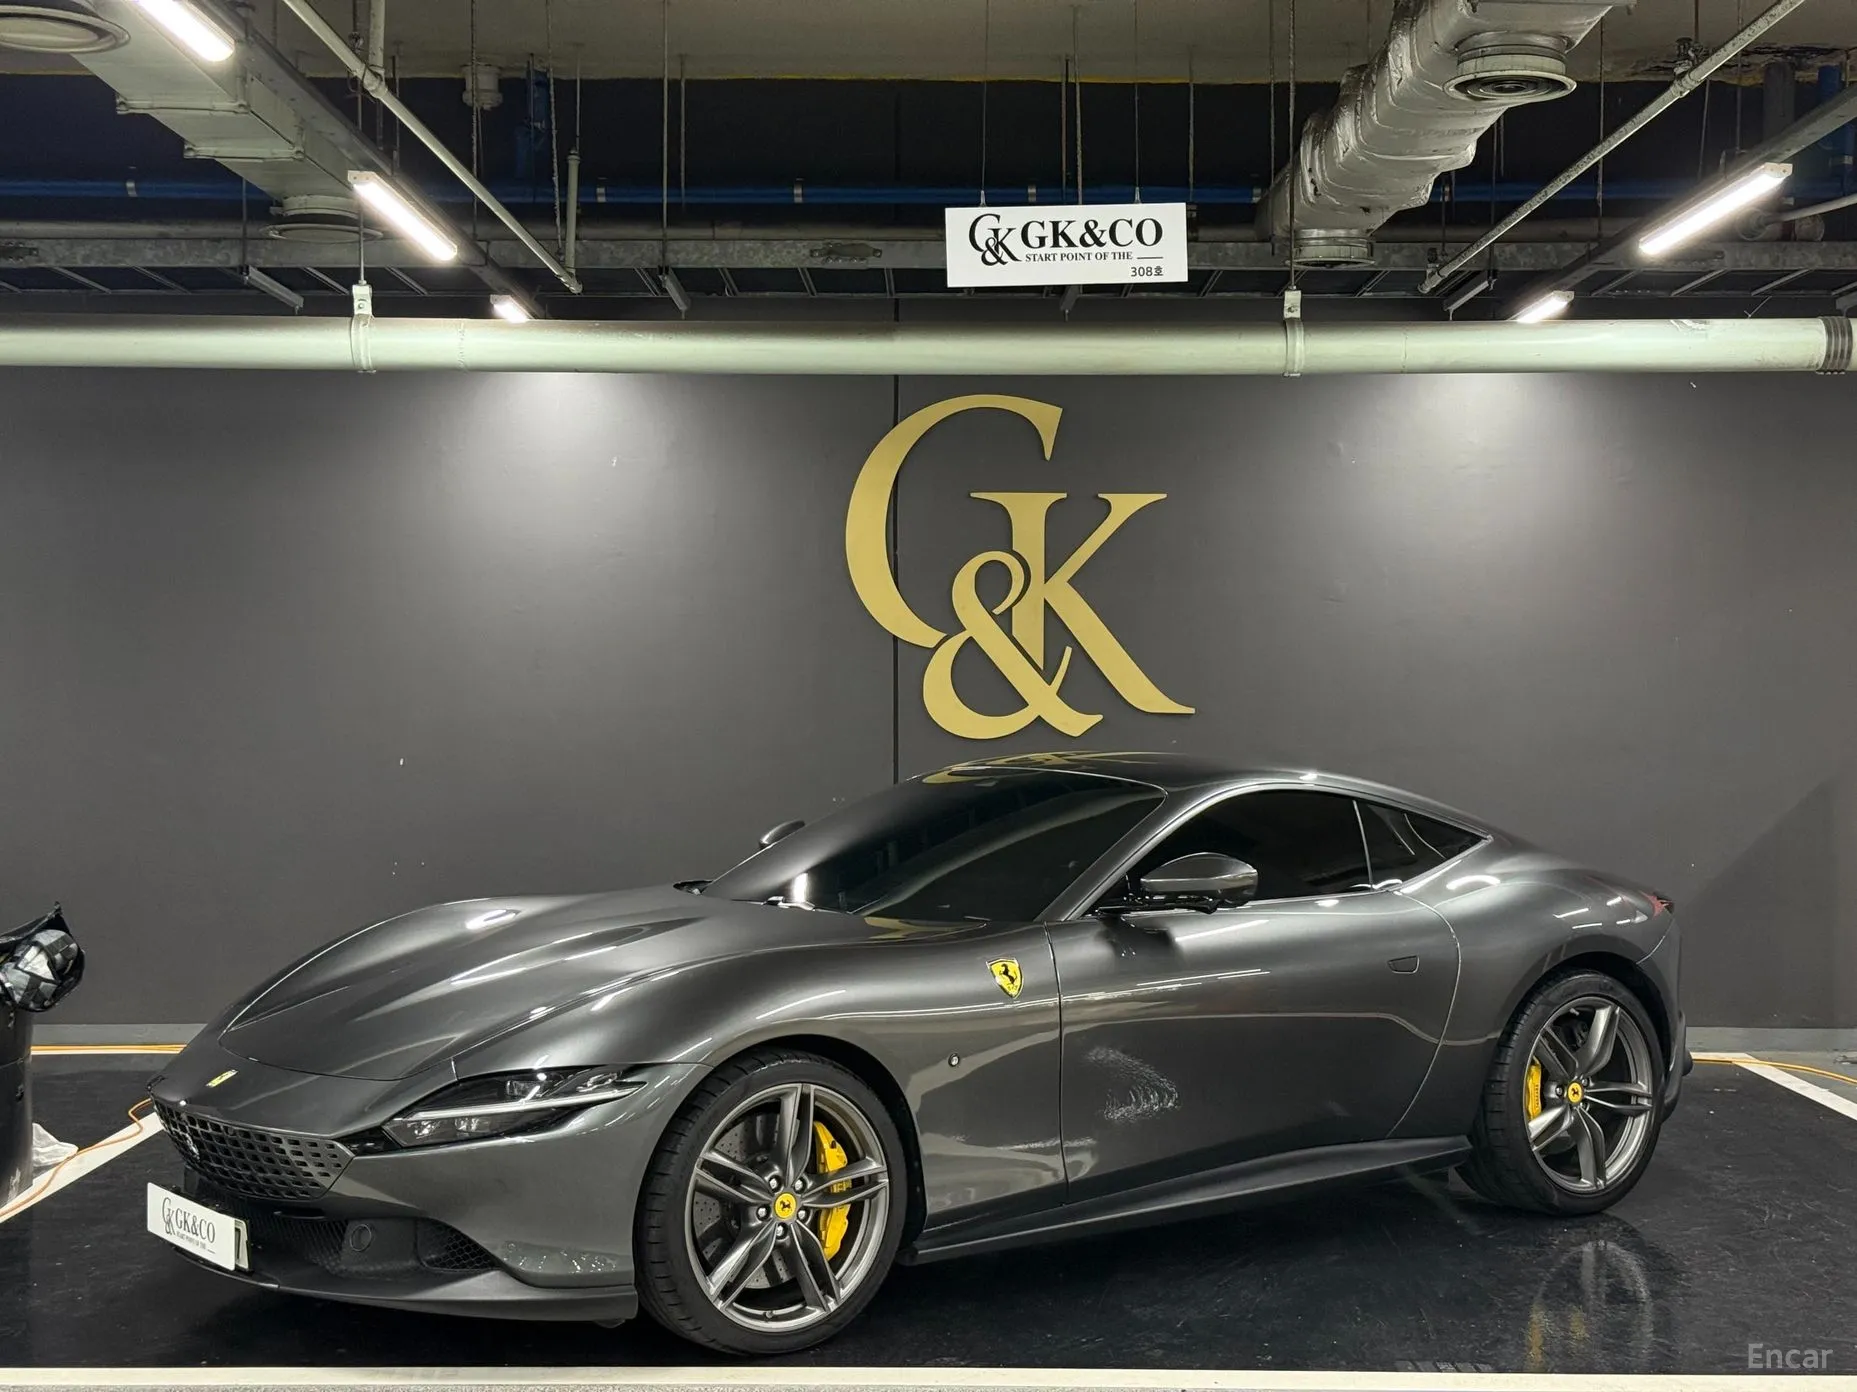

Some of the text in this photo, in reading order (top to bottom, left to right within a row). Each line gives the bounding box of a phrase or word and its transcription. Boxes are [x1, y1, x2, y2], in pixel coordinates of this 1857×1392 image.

[1020, 217, 1163, 249] GK&CO
[1025, 251, 1133, 262] START POINT OF THE
[1130, 265, 1164, 277] 308호
[175, 1208, 216, 1244] GK&CO
